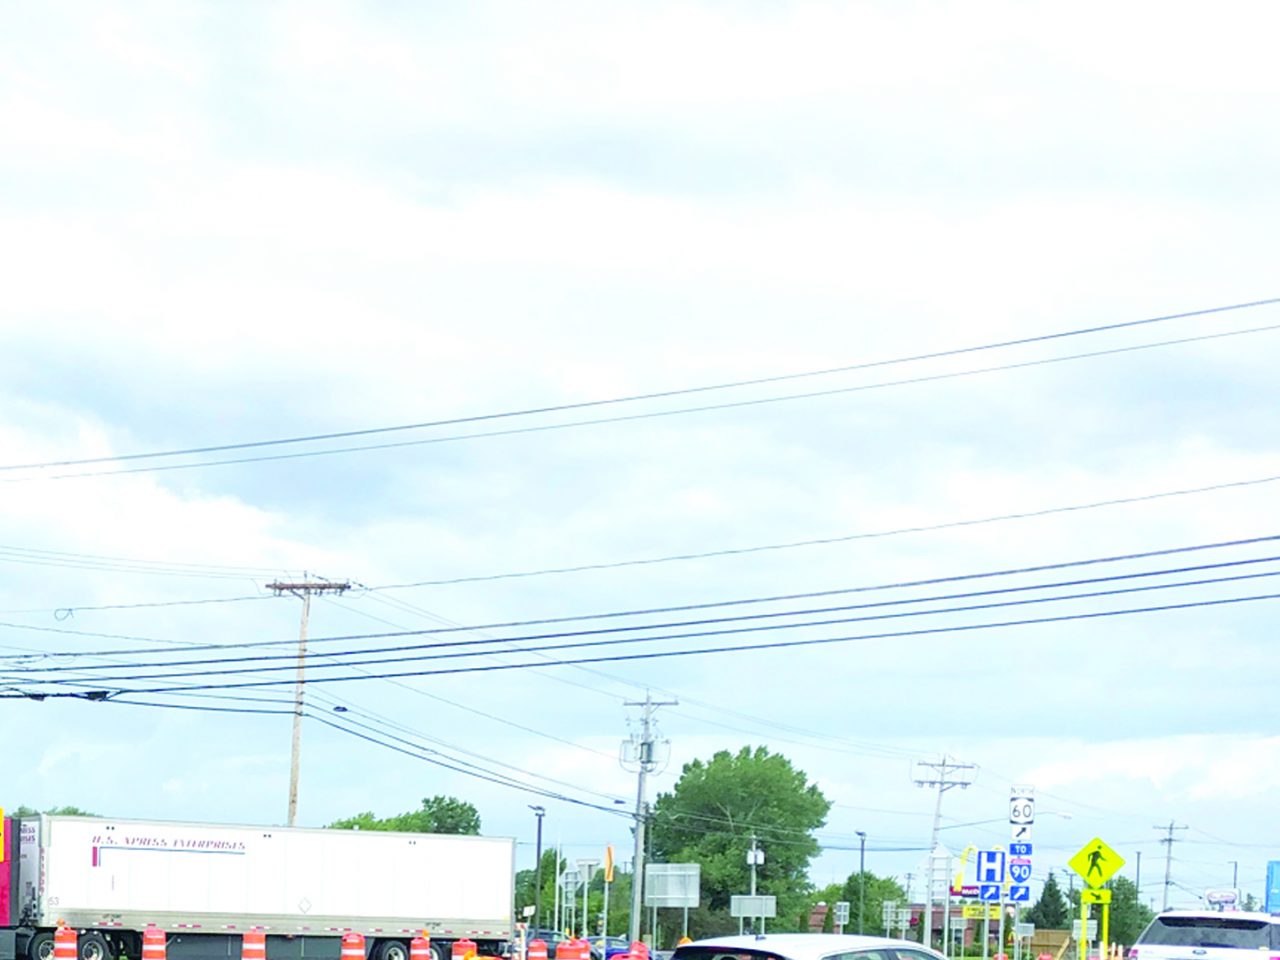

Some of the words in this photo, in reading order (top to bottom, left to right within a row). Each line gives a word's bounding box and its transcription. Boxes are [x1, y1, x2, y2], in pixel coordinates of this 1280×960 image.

[1012, 804, 1032, 818] 60
[1015, 845, 1027, 853] TO
[980, 852, 1003, 882] H
[1012, 865, 1029, 878] 90
